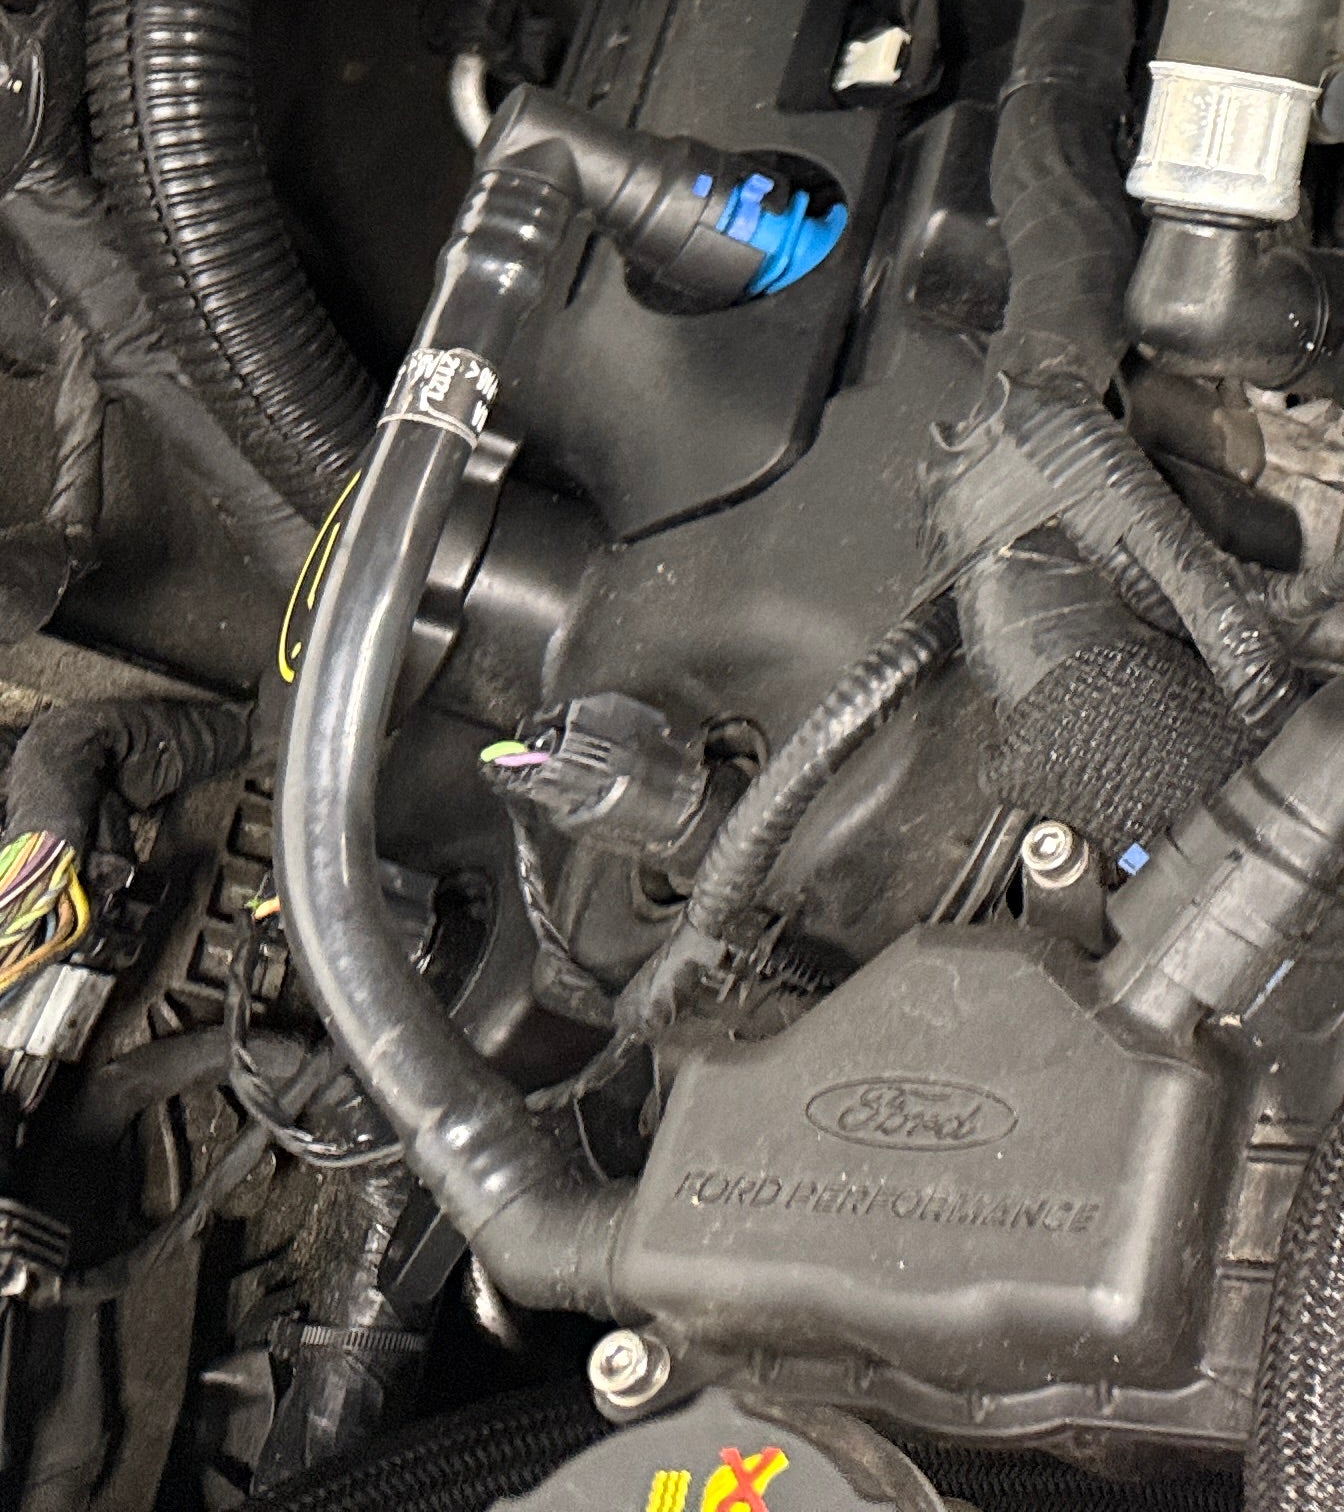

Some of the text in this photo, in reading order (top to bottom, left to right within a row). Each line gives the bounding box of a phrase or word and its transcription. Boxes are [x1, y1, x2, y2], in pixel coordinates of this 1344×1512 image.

[837, 1086, 981, 1141] Ford
[674, 1170, 1101, 1234] FORD PERFORMANCE
